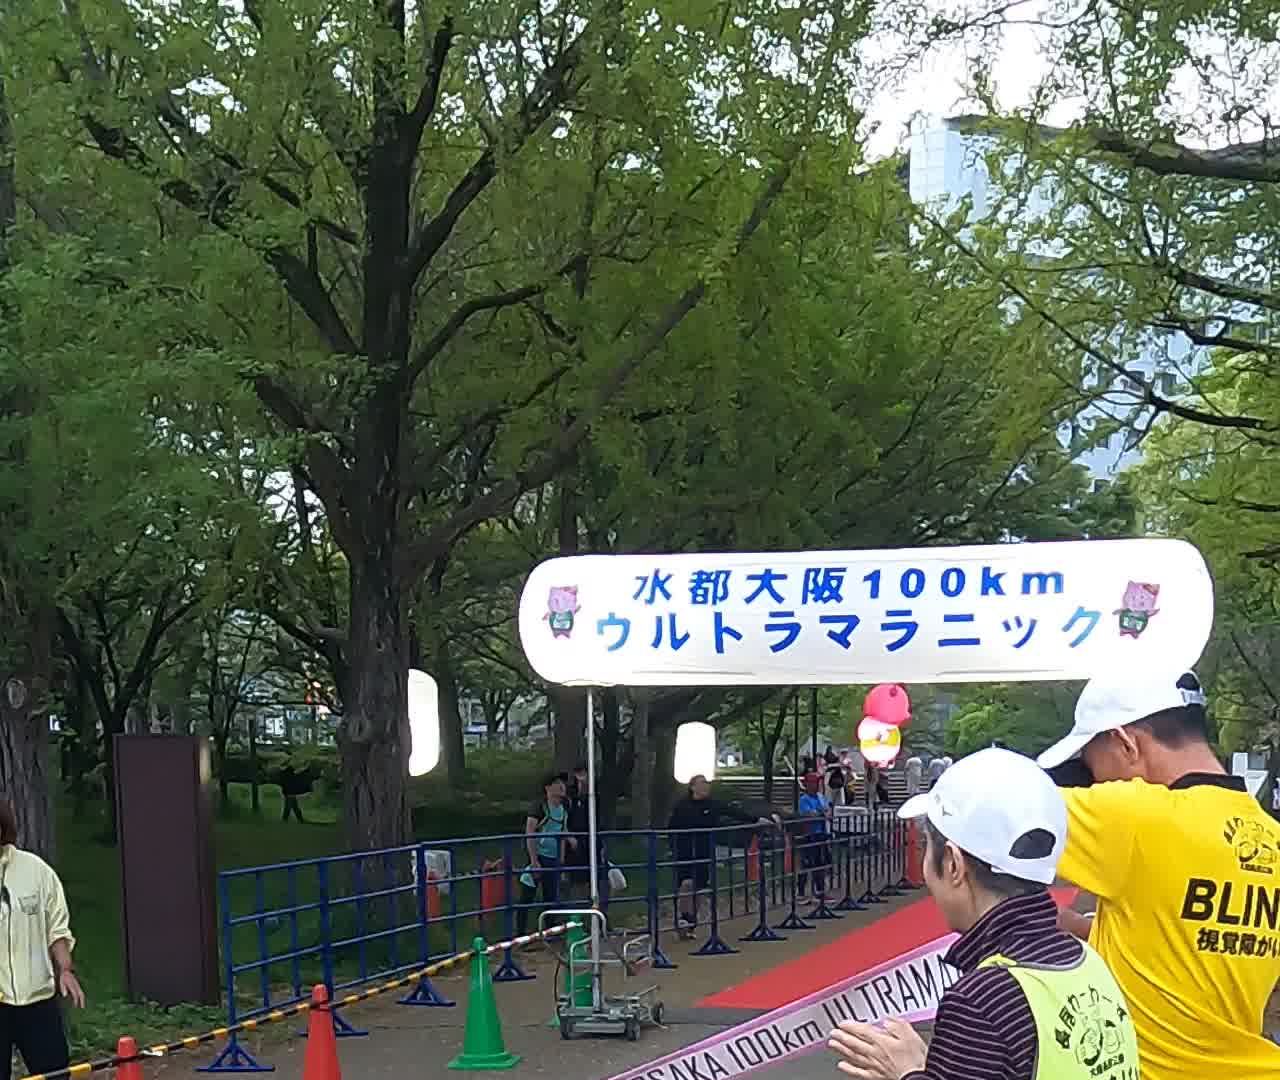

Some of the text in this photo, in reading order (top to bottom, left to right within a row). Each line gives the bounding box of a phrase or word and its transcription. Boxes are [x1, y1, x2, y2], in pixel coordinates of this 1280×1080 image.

[632, 566, 1066, 606] 水都大阪100km
[595, 606, 1104, 654] ウルトラマラニック
[726, 1018, 823, 1072] 100km
[821, 952, 963, 1027] ULTRAMA
